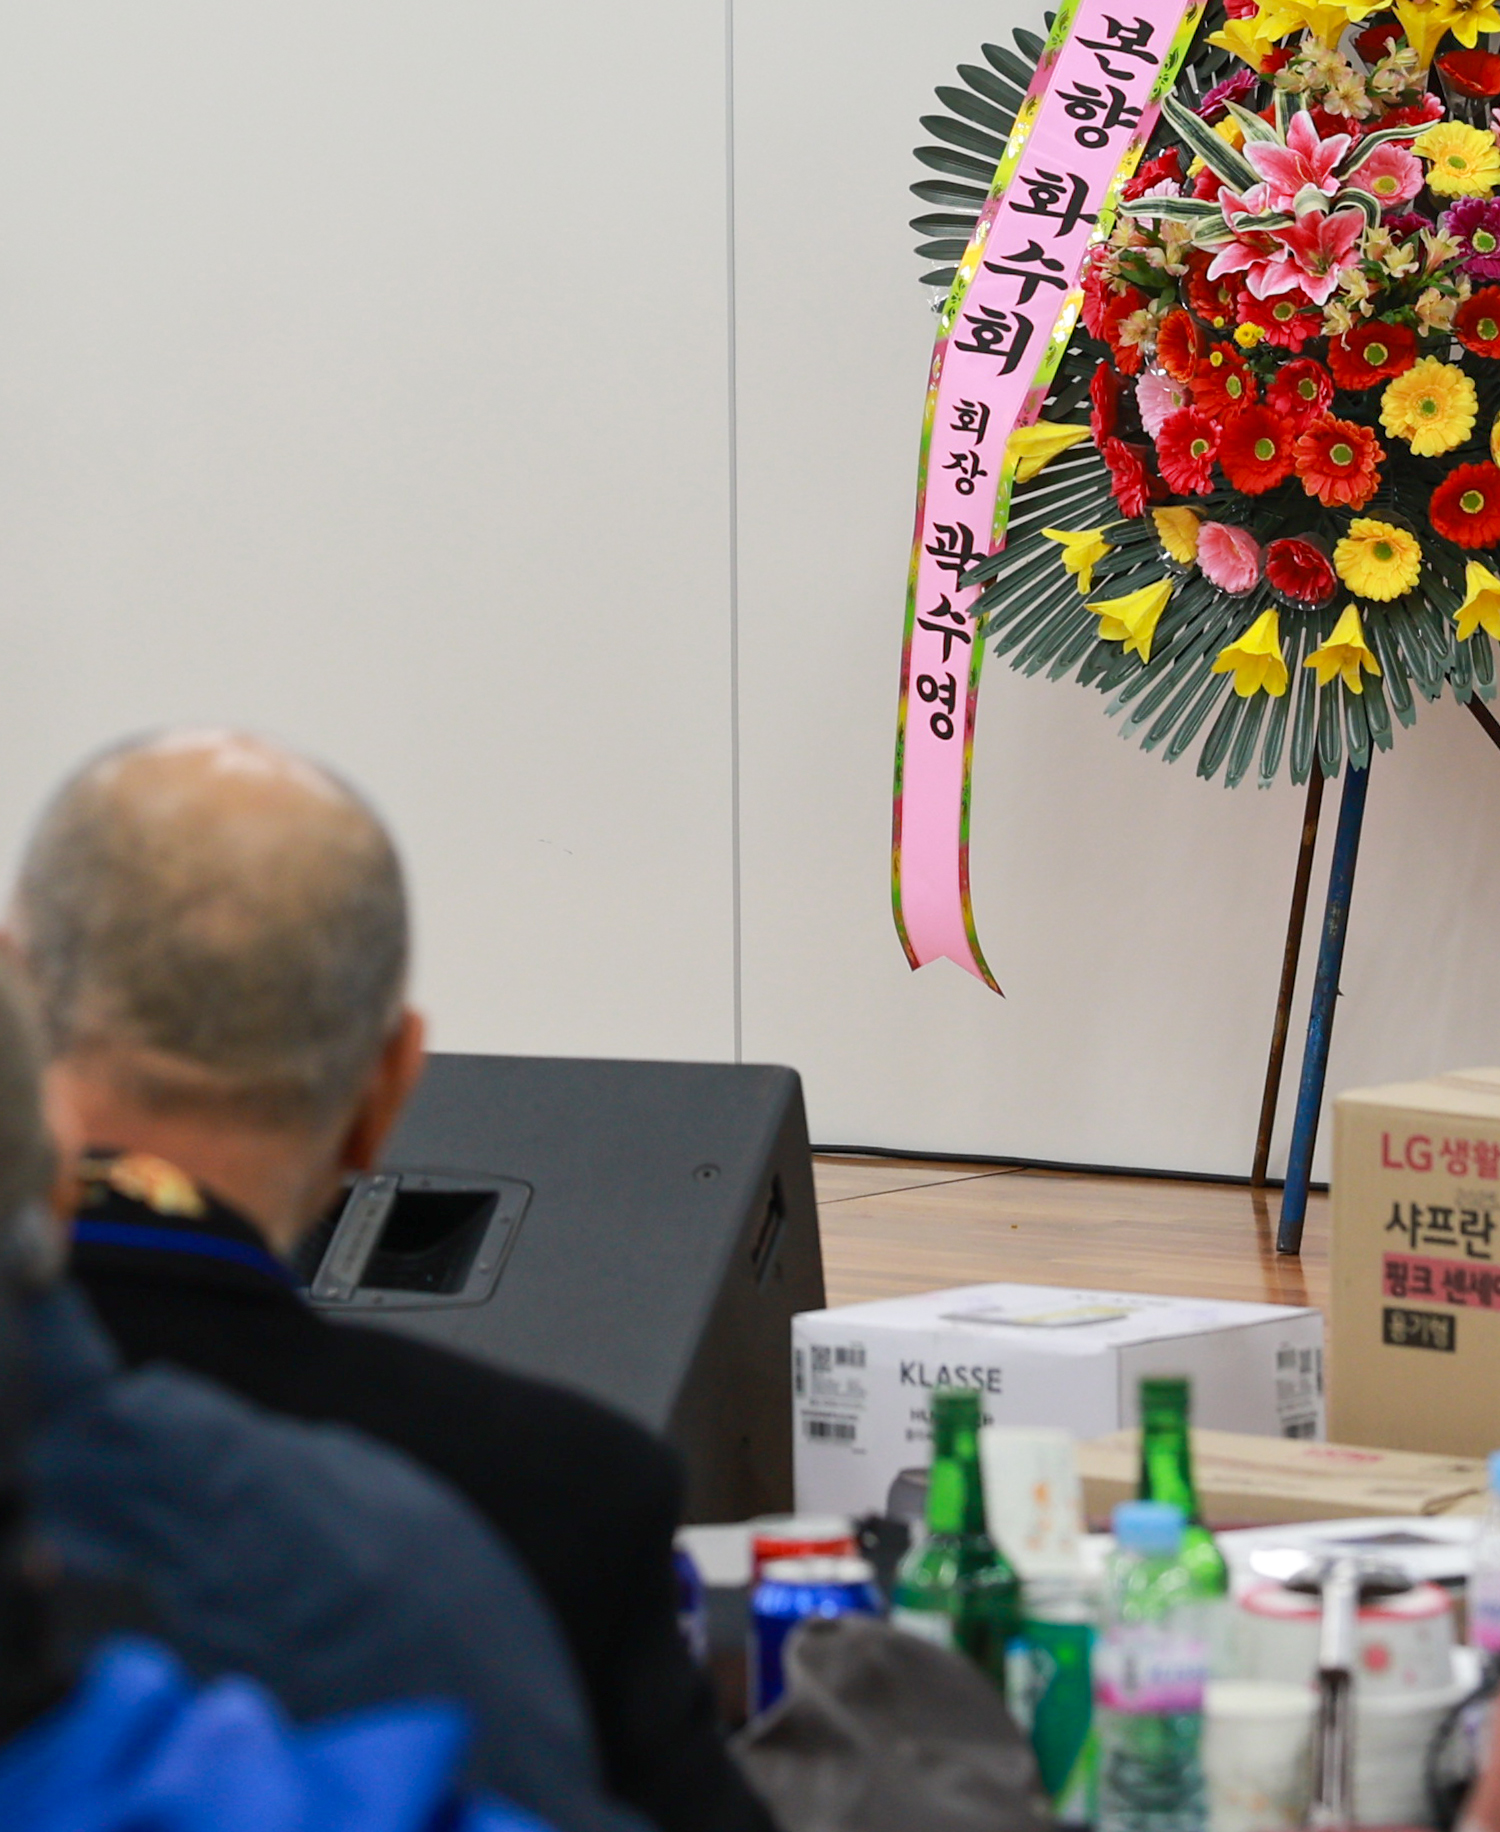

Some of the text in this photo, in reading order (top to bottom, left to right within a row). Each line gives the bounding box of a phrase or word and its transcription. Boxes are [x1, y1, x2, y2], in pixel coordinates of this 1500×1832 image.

[1054, 13, 1160, 150] 본향
[954, 167, 1099, 377] 화수회
[941, 398, 990, 496] 회장
[1386, 1201, 1495, 1260] 샤프란
[900, 1360, 1002, 1393] KLASSE
